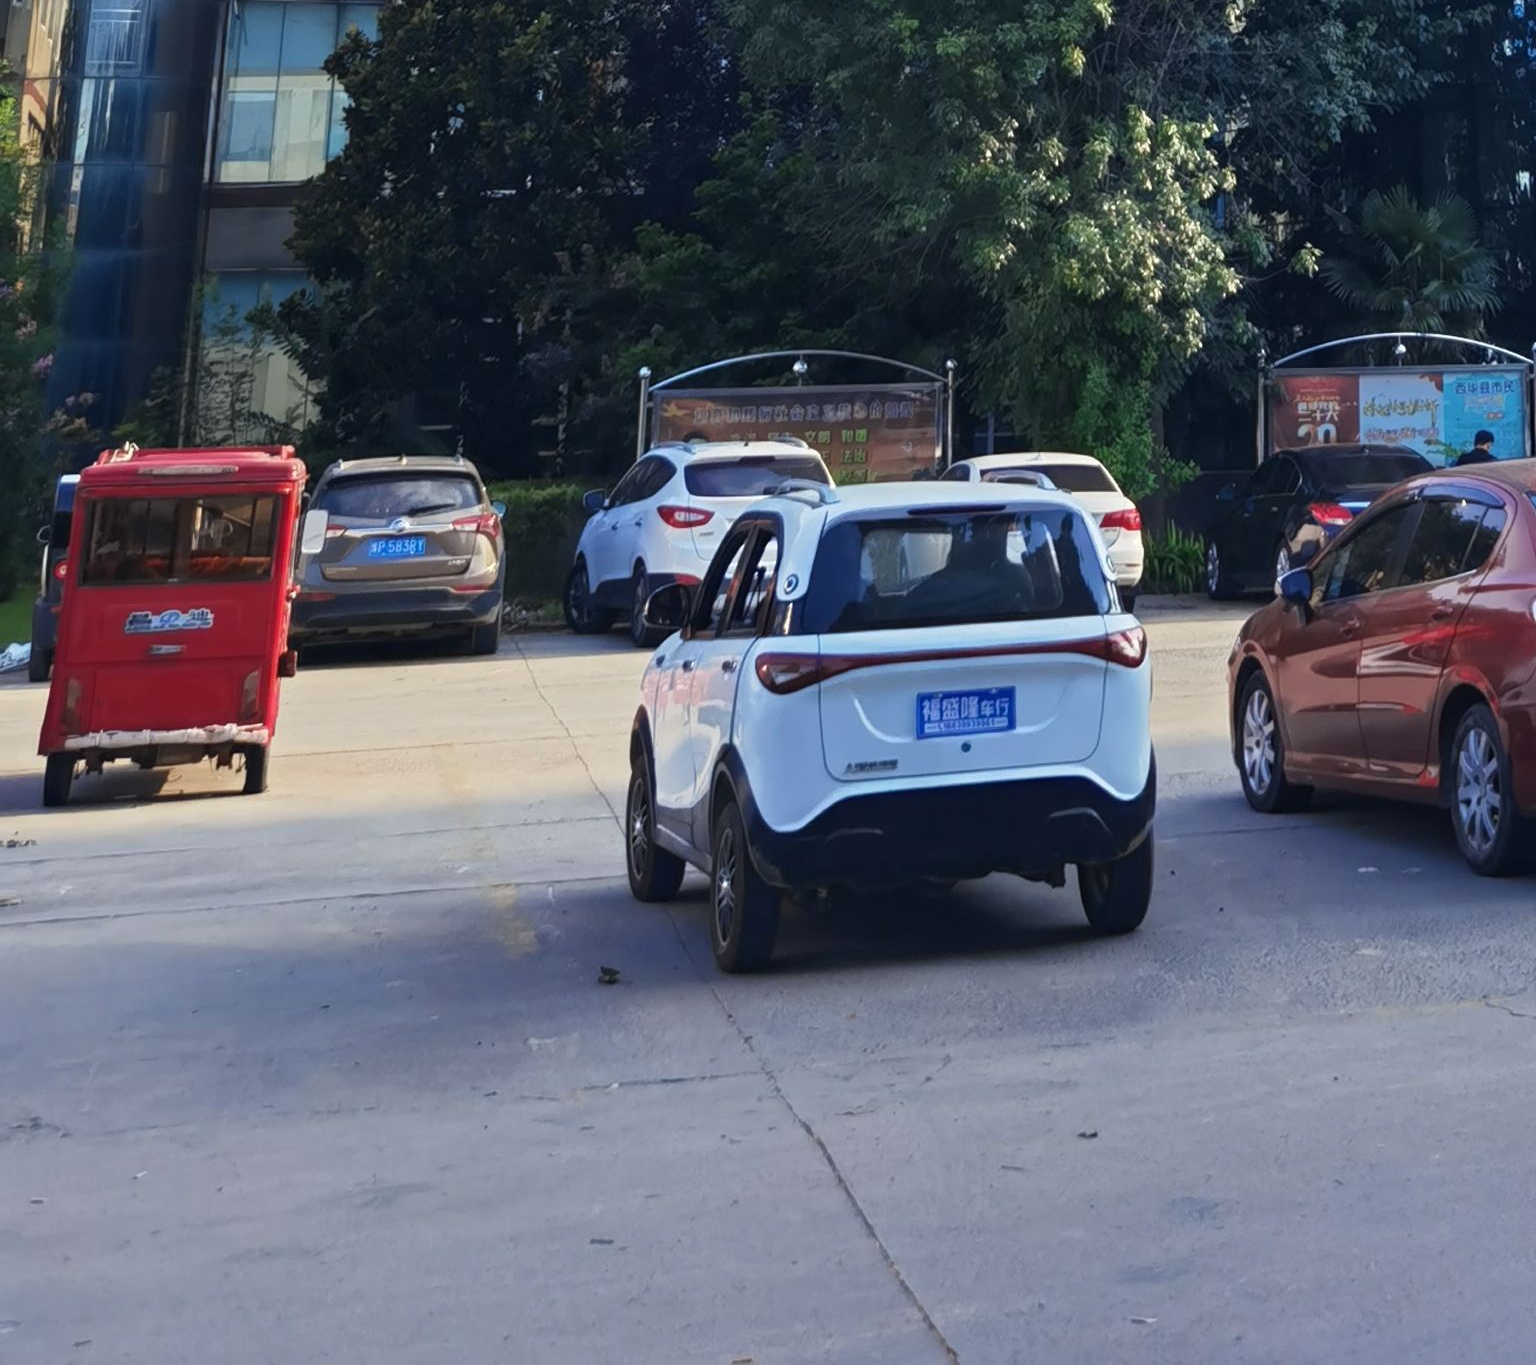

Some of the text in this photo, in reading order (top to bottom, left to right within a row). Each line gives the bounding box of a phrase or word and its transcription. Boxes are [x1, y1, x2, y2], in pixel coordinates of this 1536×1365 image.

[1455, 380, 1515, 395] 西华县市民
[922, 696, 1009, 721] 福盛隆车行
